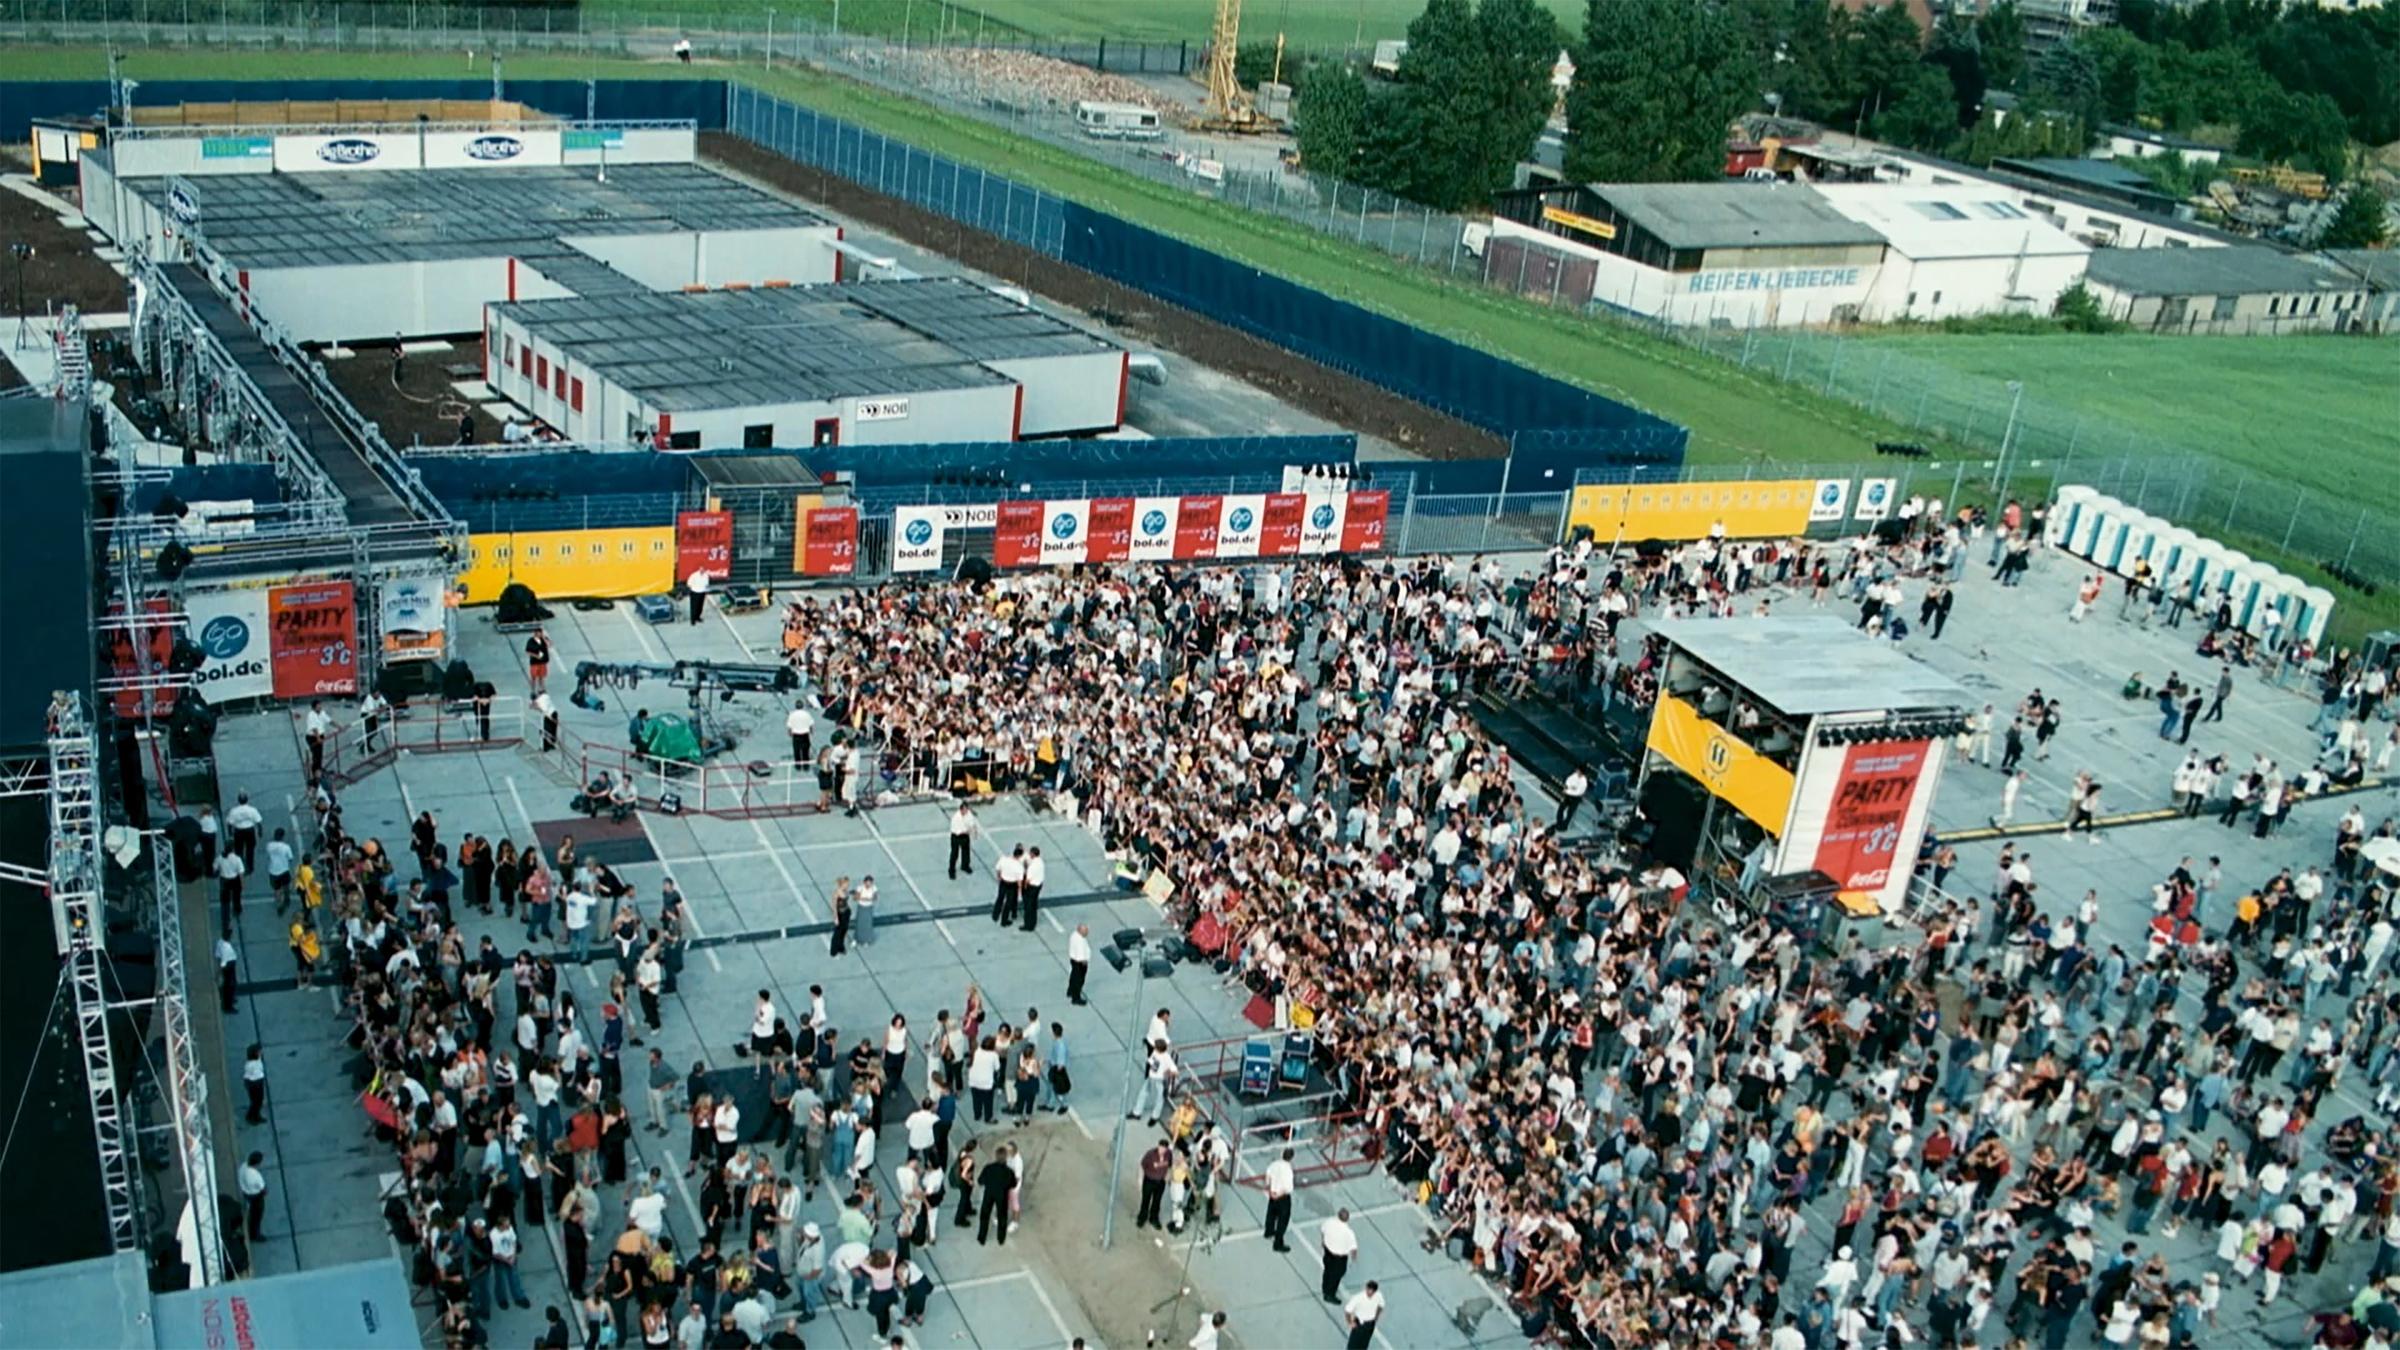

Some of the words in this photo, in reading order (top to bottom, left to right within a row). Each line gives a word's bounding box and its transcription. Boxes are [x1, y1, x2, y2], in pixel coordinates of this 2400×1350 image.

[275, 608, 347, 631] PARTY
[196, 661, 262, 684] bol.de
[1837, 775, 1917, 807] PARTY
